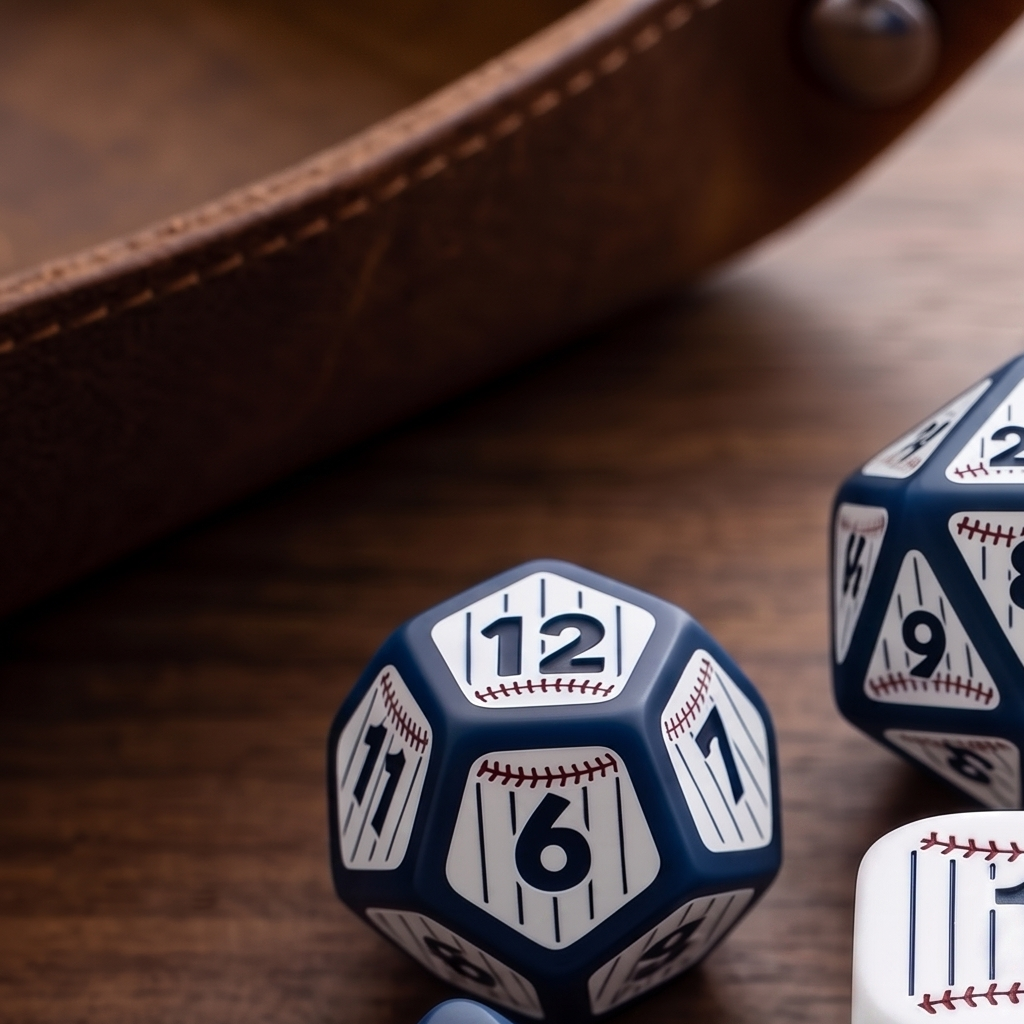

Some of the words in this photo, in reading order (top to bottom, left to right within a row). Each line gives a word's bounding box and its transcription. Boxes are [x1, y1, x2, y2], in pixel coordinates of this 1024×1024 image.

[480, 613, 606, 677] 12
[902, 610, 946, 678] 9
[353, 722, 406, 839] 11
[695, 707, 744, 805] 7
[515, 792, 592, 892] 6
